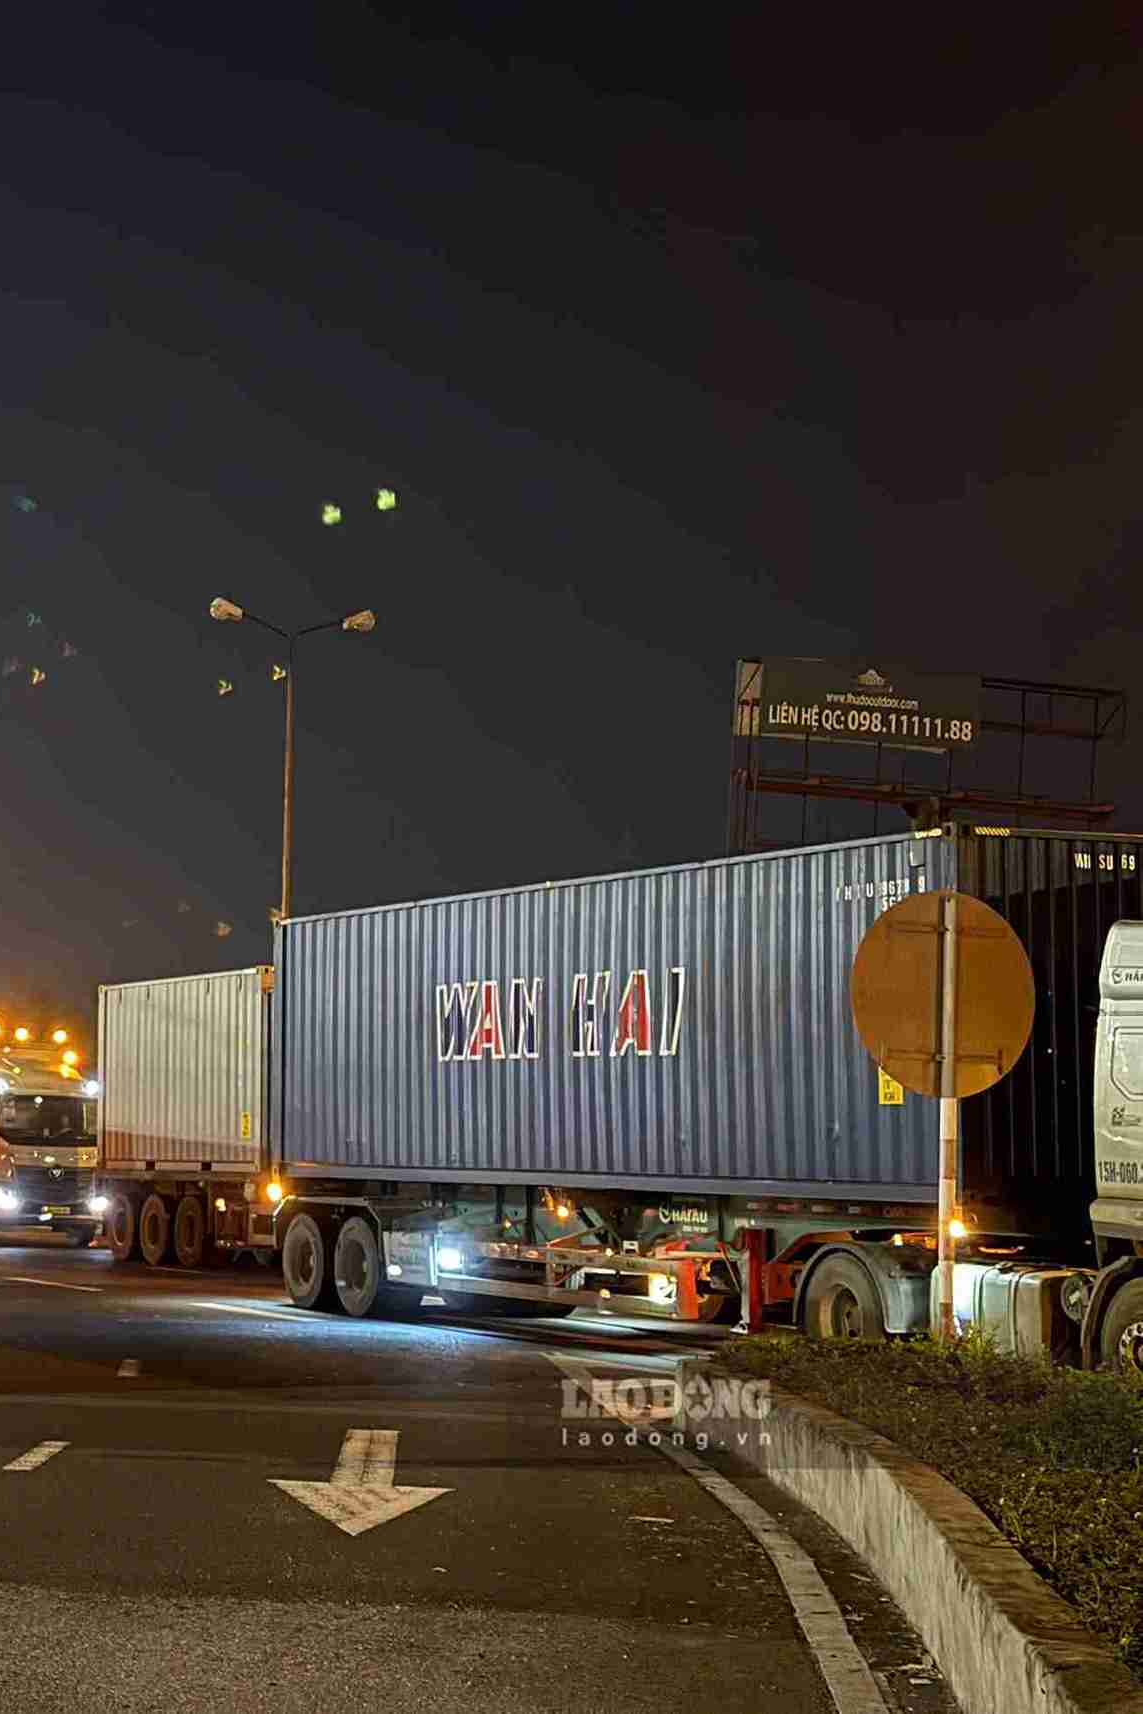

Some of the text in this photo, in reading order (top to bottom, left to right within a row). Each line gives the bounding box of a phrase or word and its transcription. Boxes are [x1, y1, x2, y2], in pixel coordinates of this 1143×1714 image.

[769, 701, 972, 741] LIÊN HỆ QC: 098.11111.88
[436, 966, 685, 1061] WAN HAI
